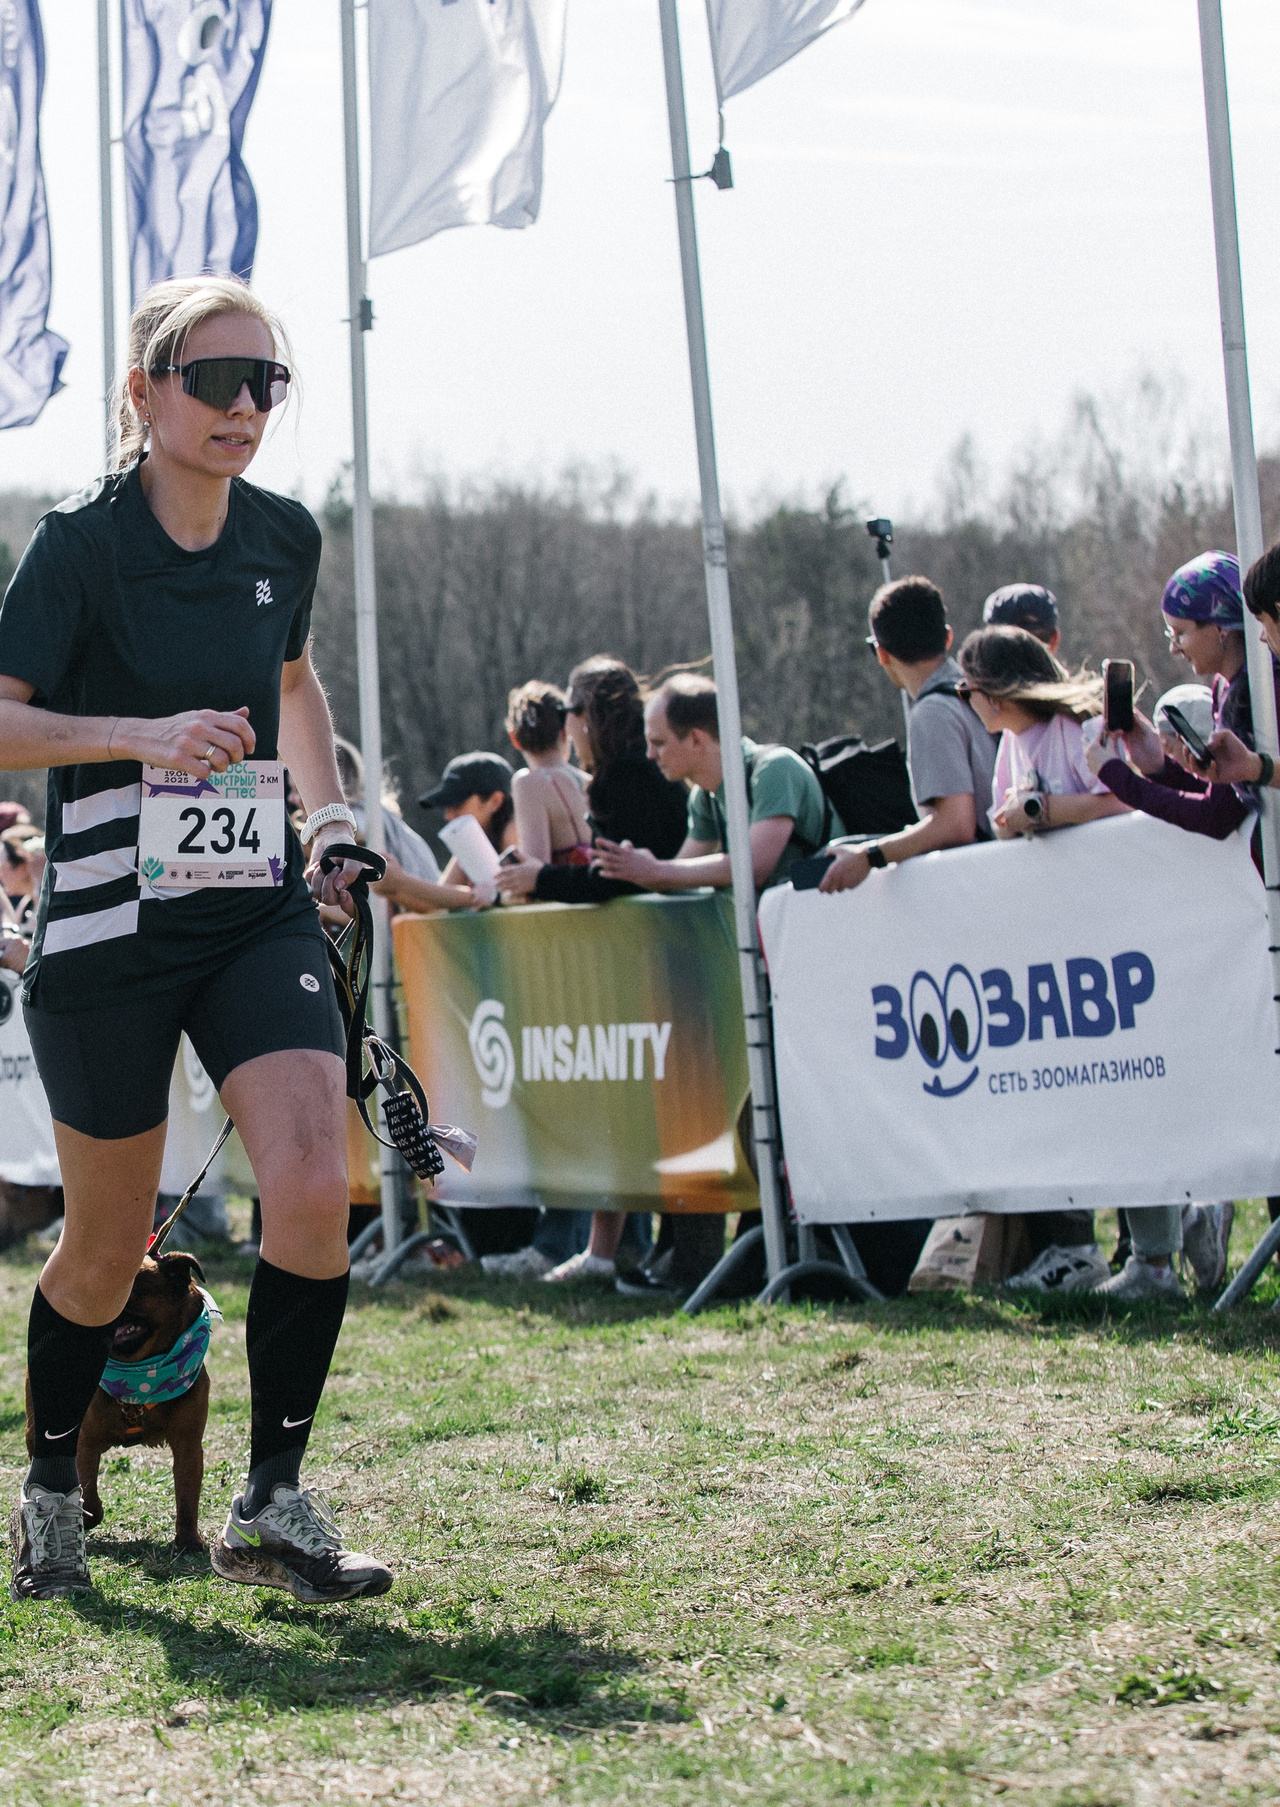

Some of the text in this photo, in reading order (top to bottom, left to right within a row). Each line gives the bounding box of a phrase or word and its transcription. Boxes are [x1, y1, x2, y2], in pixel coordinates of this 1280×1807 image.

[164, 776, 189, 784] 2025
[259, 774, 266, 784] 2
[177, 806, 261, 855] 234
[871, 951, 1156, 1070] ЗООЗАВР
[521, 1021, 673, 1083] INSANITY
[988, 1055, 1167, 1095] СЕТЬ ЗООМАГАЗИНОВ
